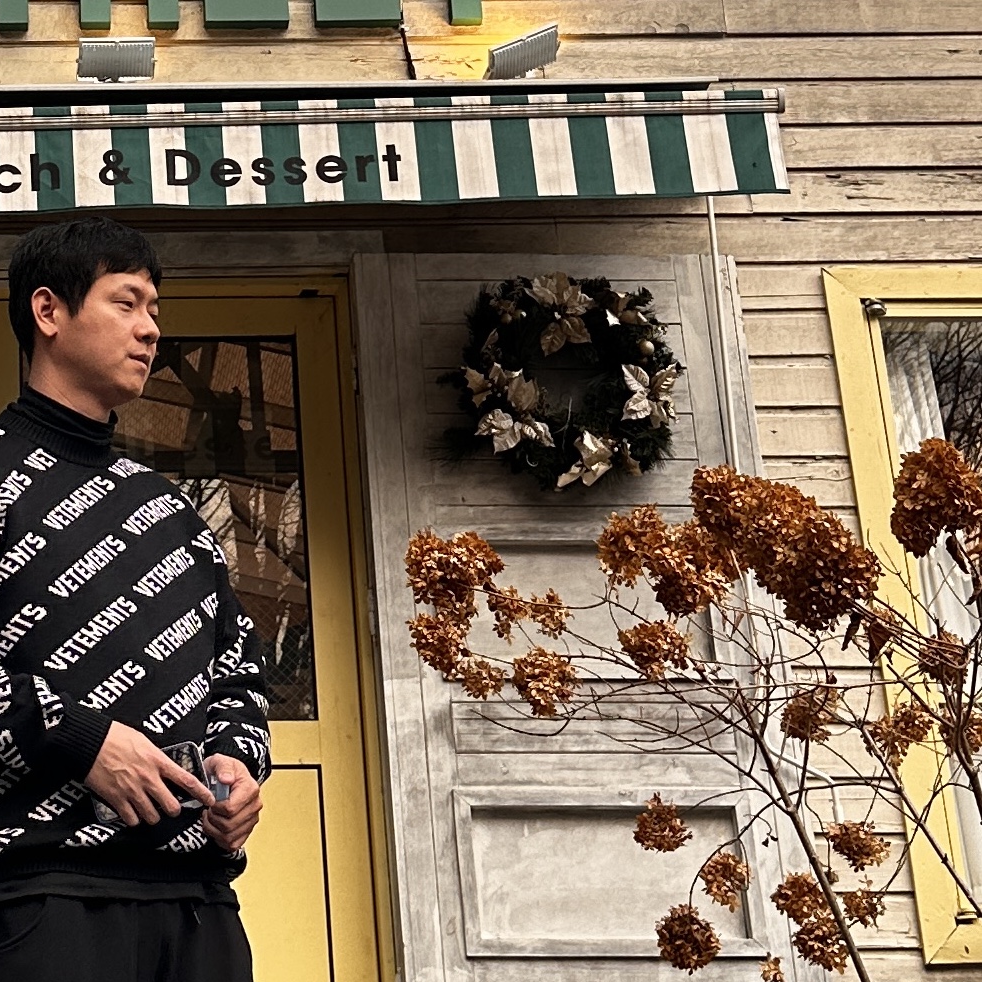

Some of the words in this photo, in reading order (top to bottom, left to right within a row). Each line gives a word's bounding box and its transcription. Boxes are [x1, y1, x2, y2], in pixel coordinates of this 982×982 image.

[99, 149, 134, 186] &
[165, 143, 402, 187] Dessert
[42, 475, 116, 530] VETEMENTS
[47, 534, 127, 598] VETEMENTS
[121, 493, 186, 536] VETEMENTS
[43, 595, 139, 671] VETEMENTS
[131, 545, 196, 597] VETEMENTS
[143, 608, 203, 662] VETEMENTS
[142, 672, 210, 733] VETEMENTS
